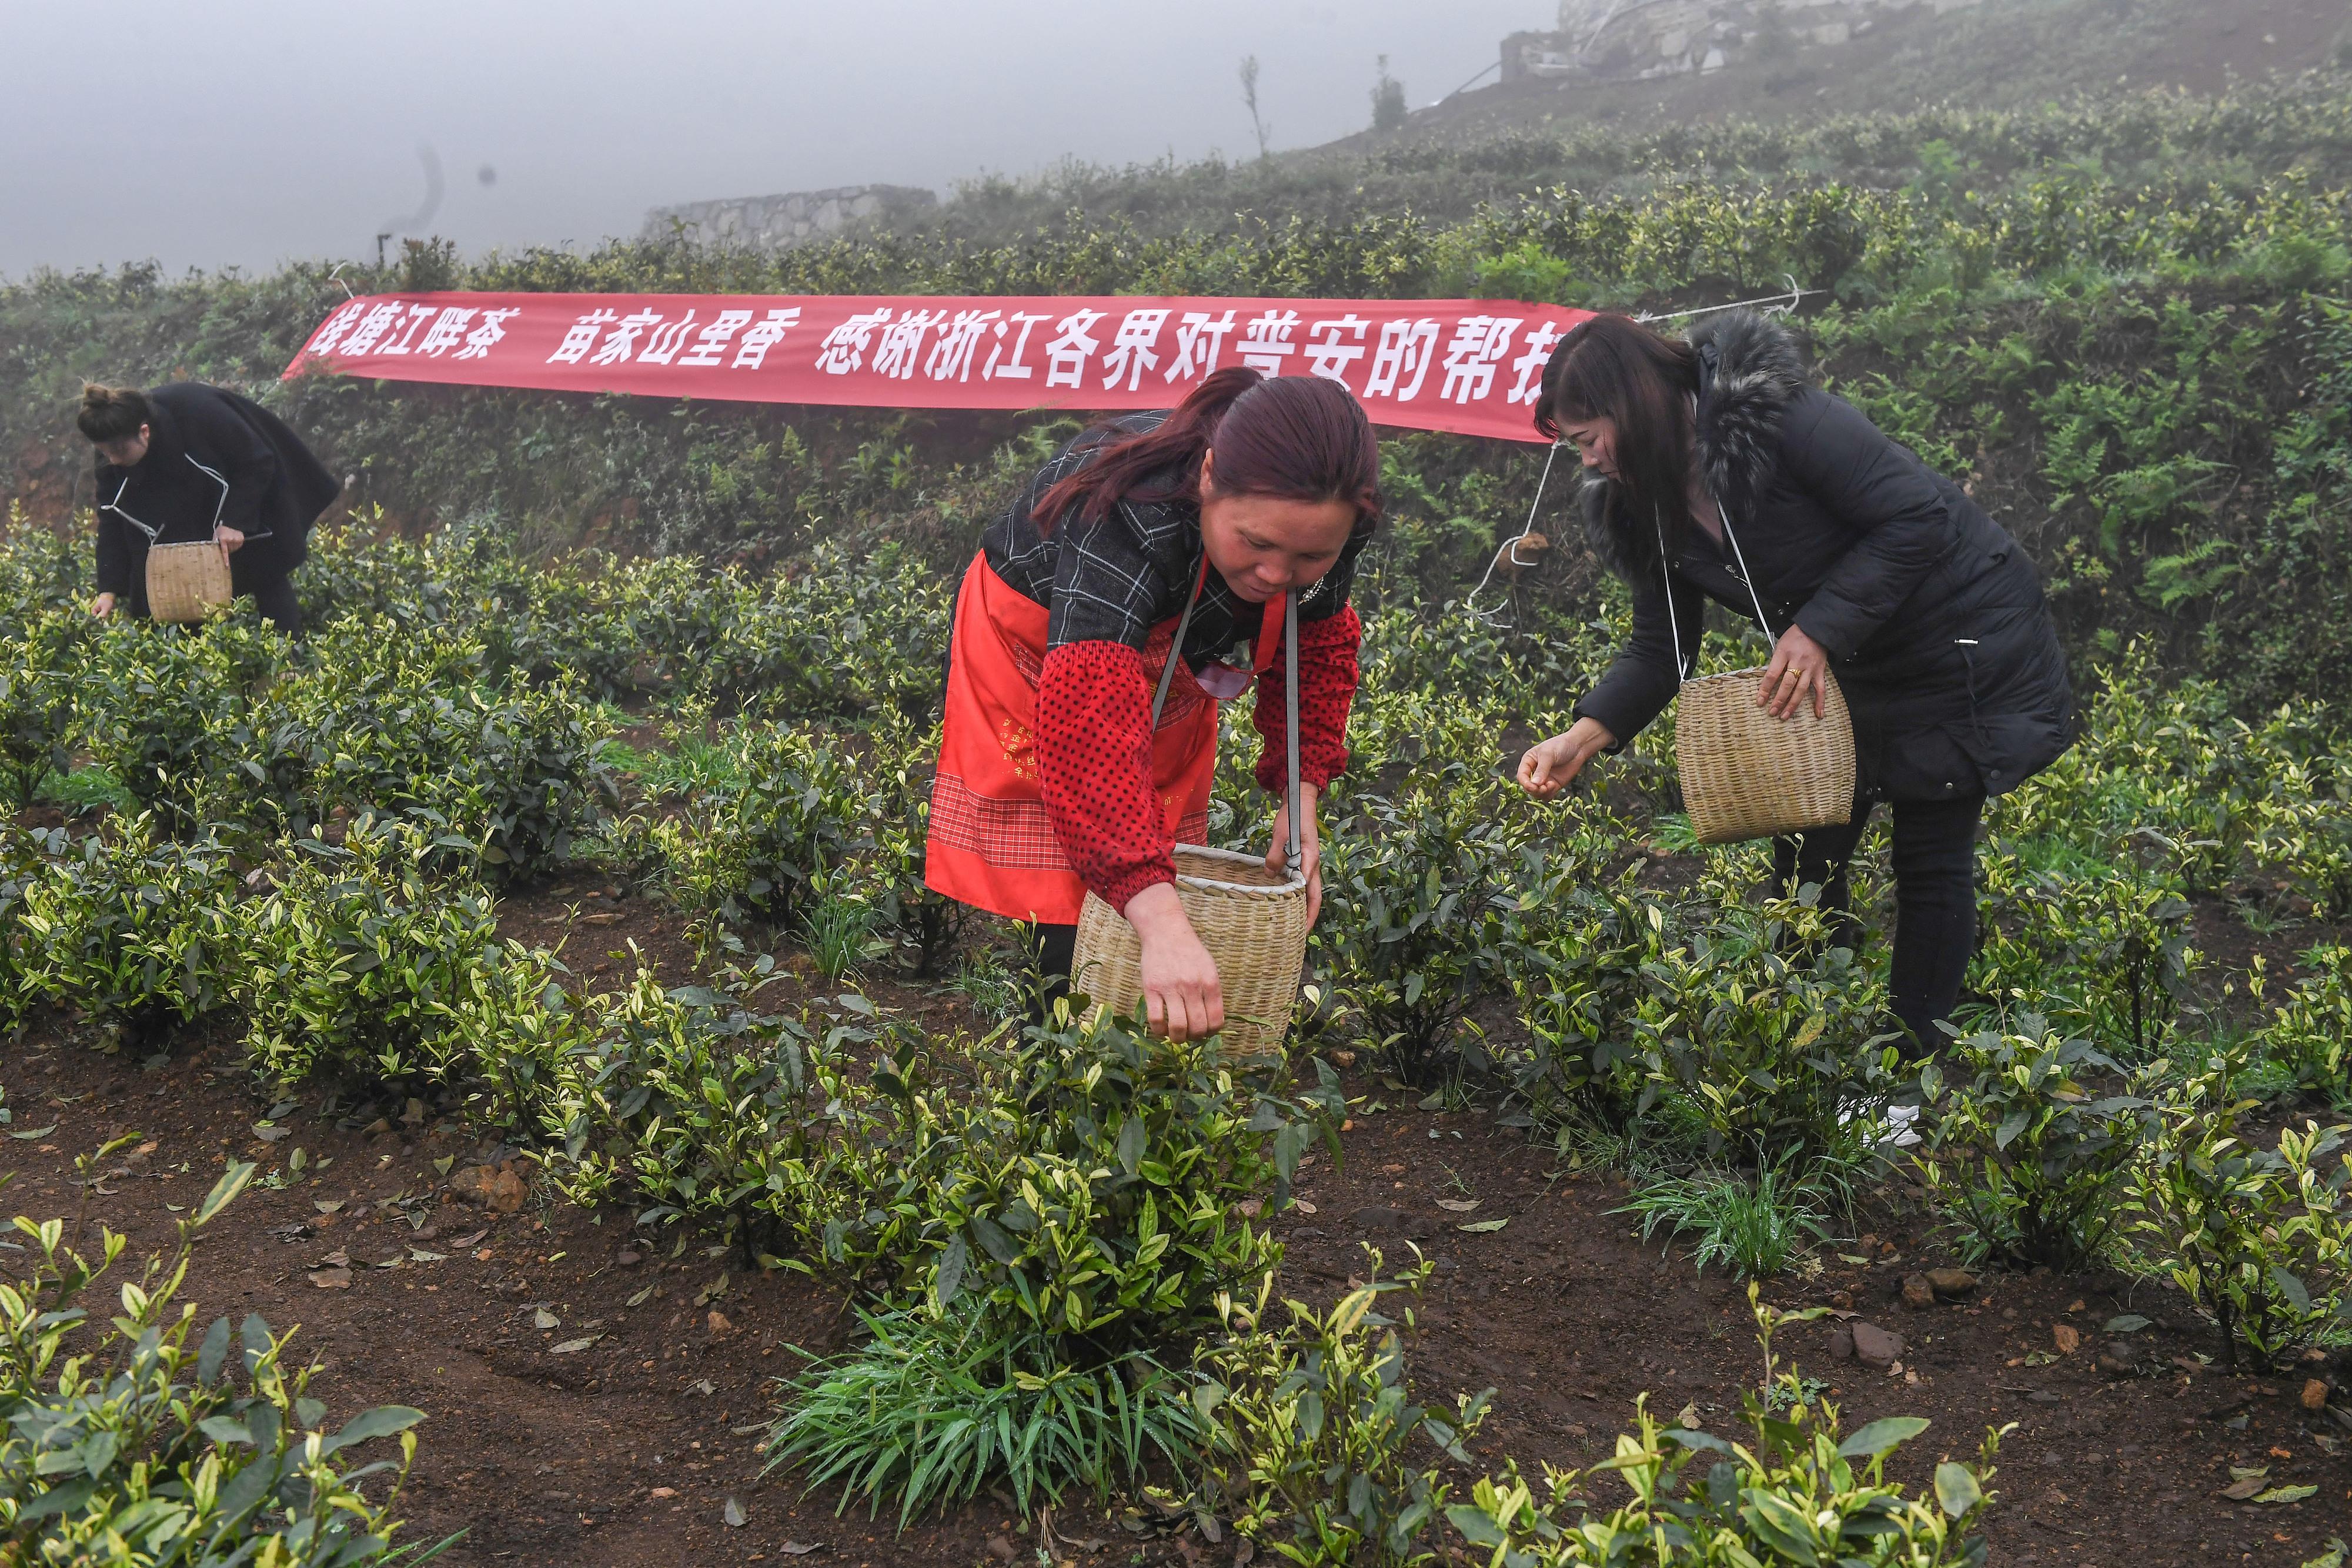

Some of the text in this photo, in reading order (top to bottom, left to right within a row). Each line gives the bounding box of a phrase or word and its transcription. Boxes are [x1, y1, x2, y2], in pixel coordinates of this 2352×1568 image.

[308, 300, 521, 360] 钱塘江畔茶
[546, 307, 801, 370] 苗家山里香
